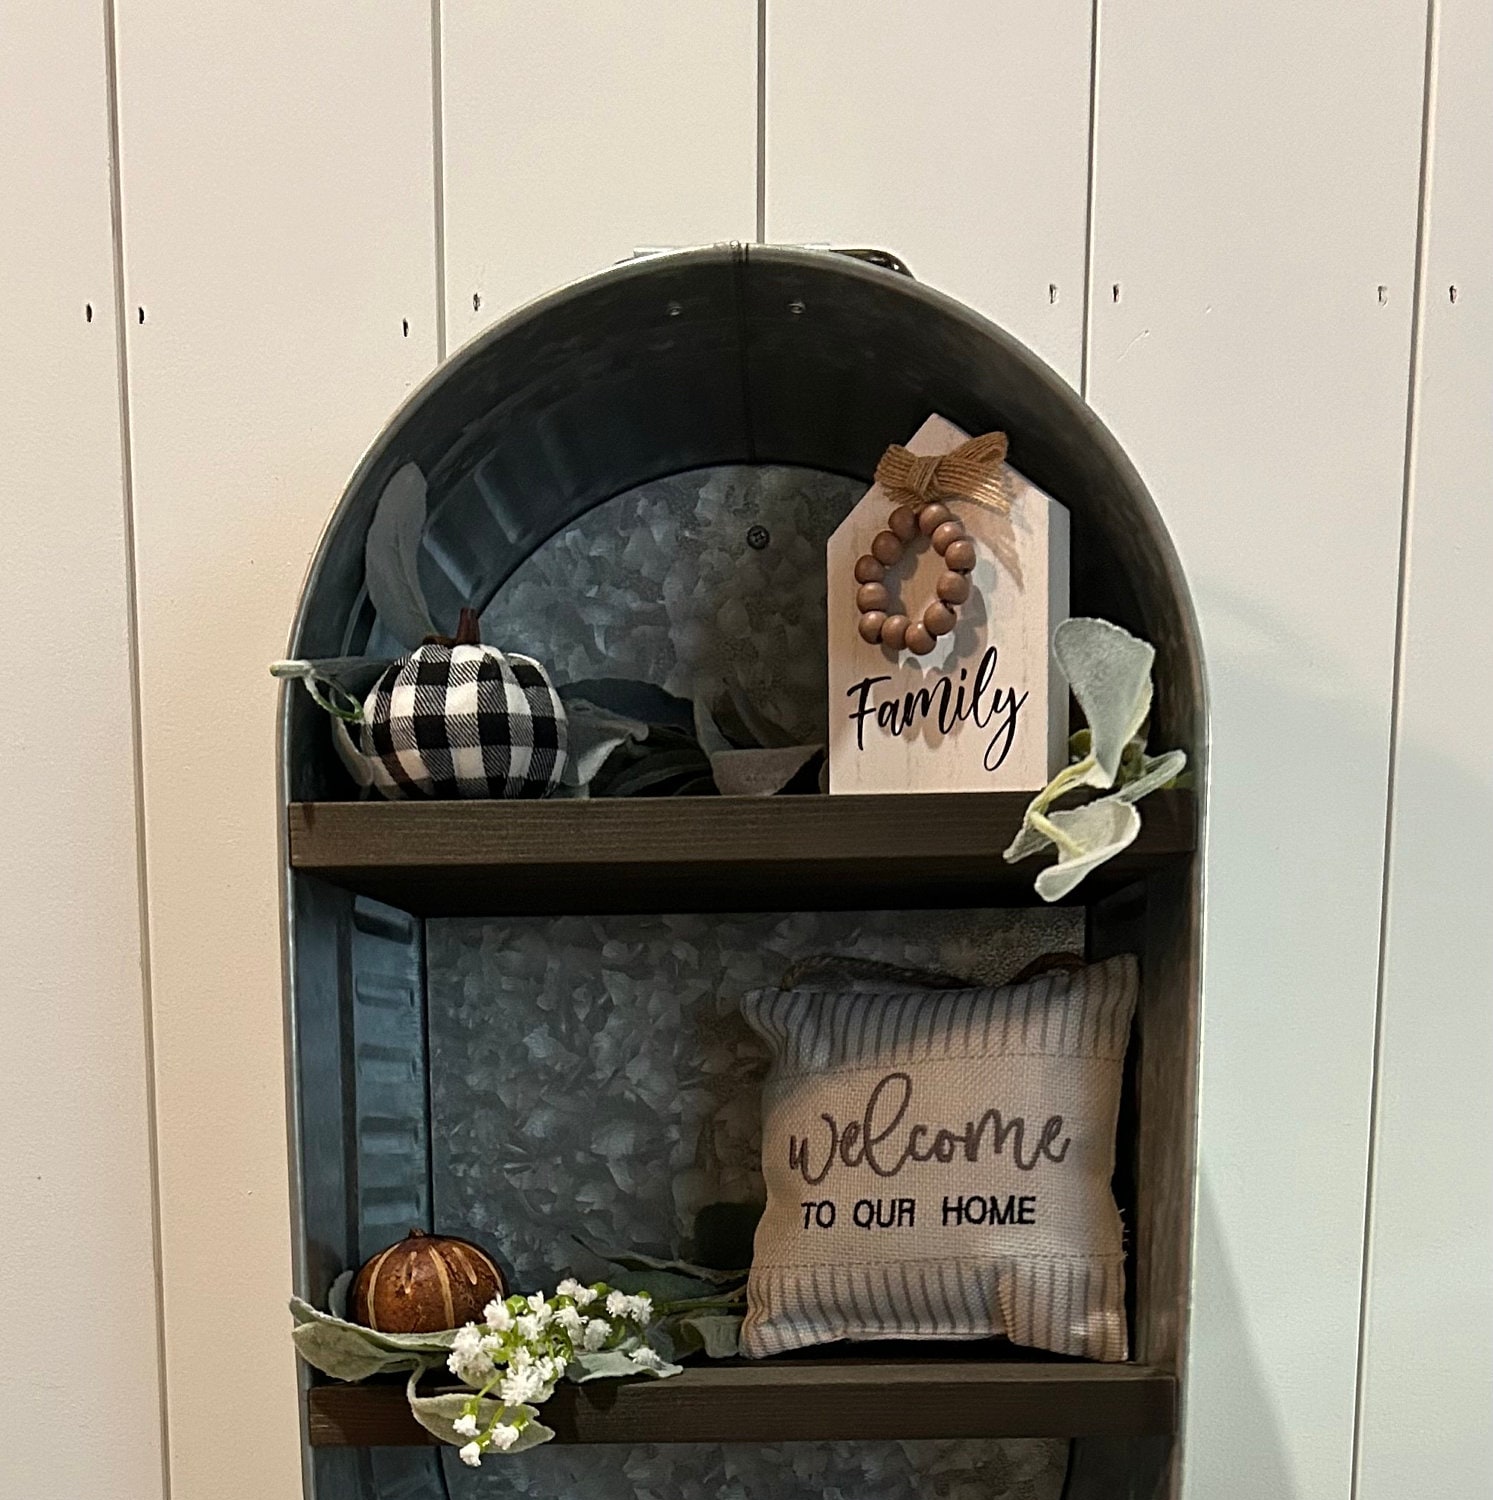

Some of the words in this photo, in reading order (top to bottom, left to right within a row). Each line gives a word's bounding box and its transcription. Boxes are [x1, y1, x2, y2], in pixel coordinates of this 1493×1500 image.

[847, 646, 1029, 771] Family
[788, 1071, 1071, 1185] welcome
[800, 1200, 836, 1230] TO
[853, 1198, 915, 1231] OUR
[942, 1195, 1037, 1226] HOME
